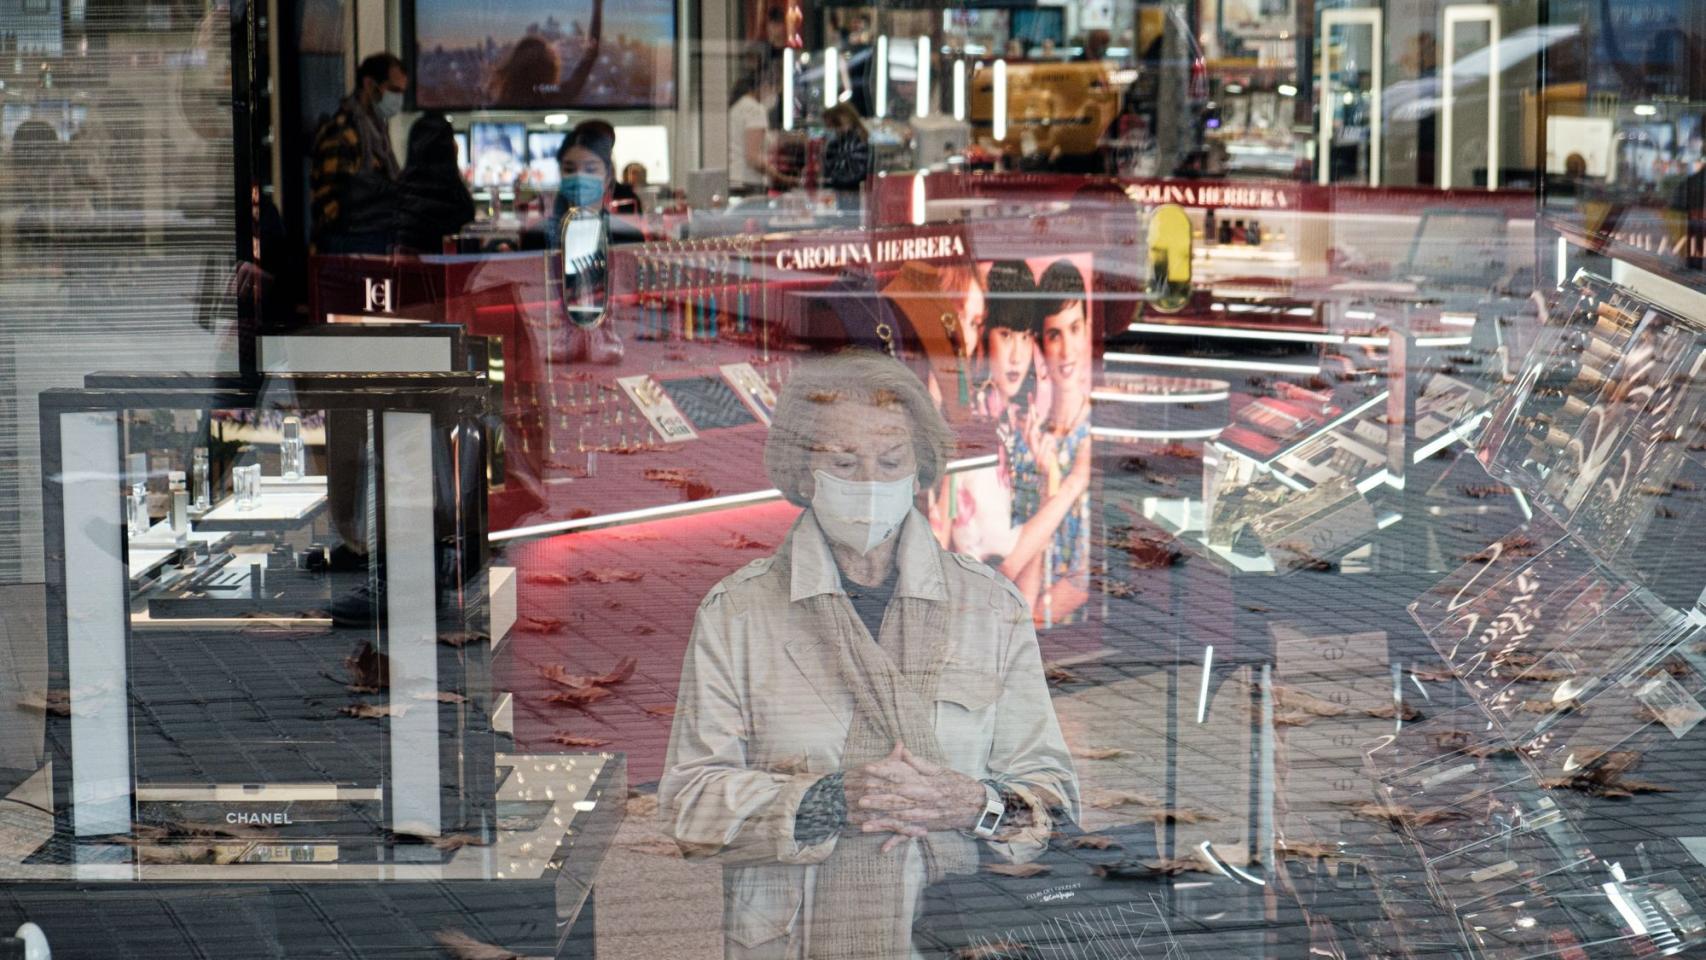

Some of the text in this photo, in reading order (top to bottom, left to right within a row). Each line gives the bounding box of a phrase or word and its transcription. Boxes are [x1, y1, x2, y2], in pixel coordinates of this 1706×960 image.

[776, 235, 965, 271] CAROLINA HERRERA
[226, 812, 293, 825] CHANEL
